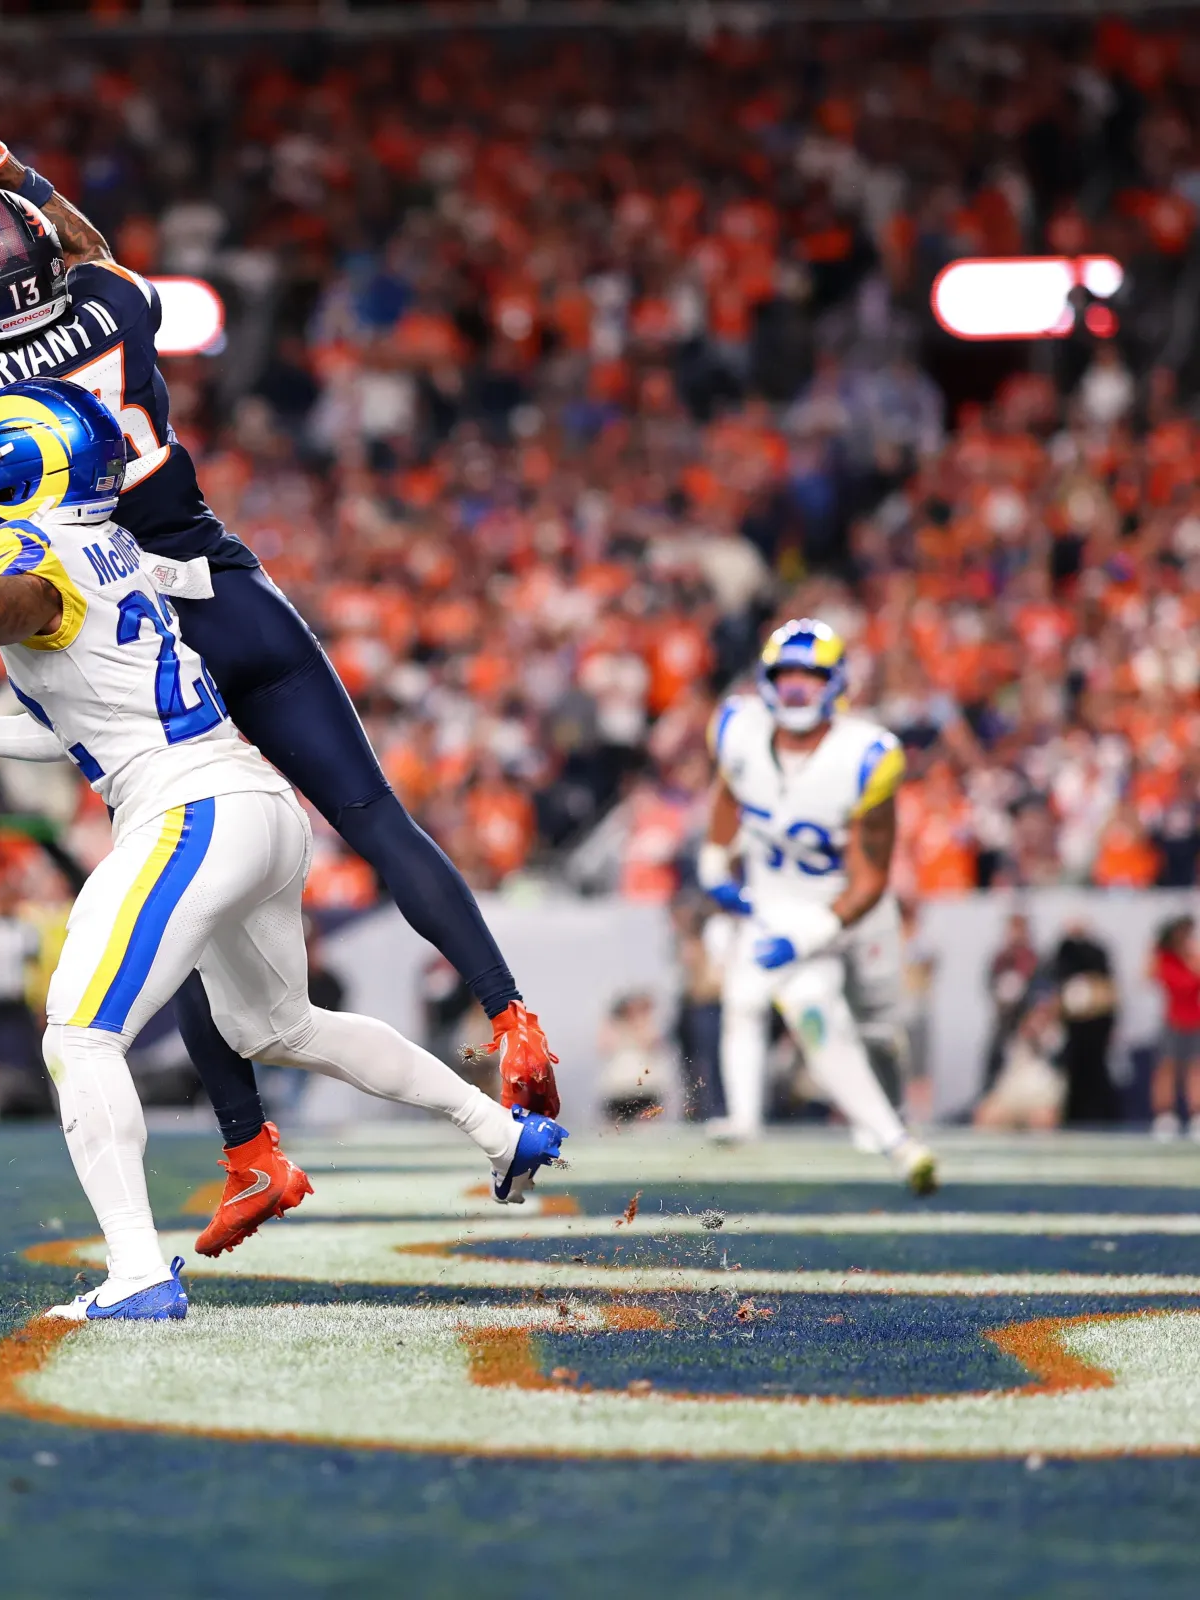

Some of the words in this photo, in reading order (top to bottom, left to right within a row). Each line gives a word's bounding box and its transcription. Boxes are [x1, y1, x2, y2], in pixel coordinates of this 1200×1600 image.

[8, 275, 41, 311] 13
[2, 307, 51, 330] BRONCOS
[81, 300, 119, 337] II
